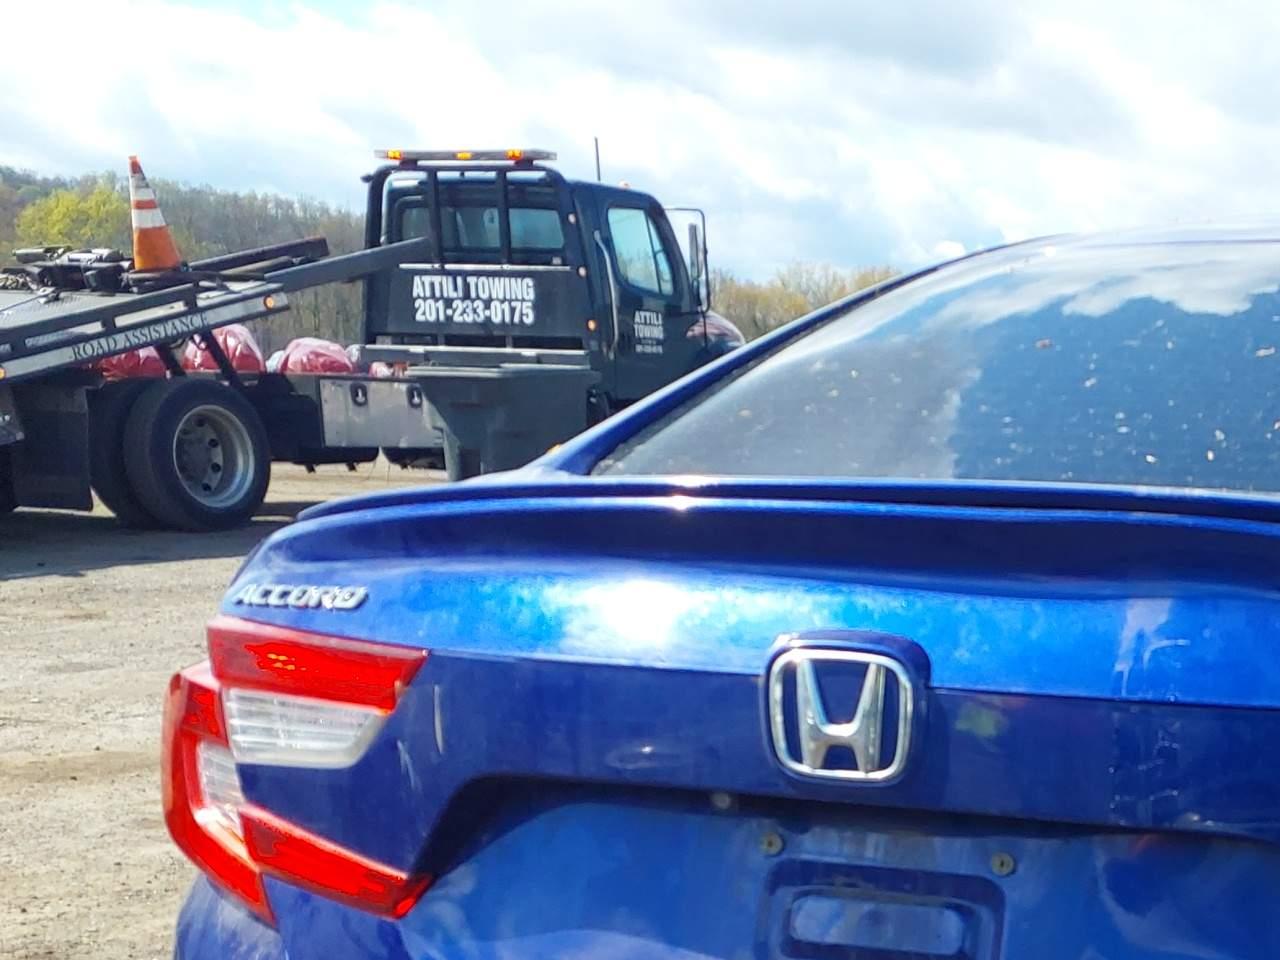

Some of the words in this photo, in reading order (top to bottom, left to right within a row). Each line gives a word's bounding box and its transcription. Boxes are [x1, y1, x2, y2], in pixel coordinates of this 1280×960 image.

[412, 274, 463, 299] ATTILI
[466, 275, 536, 300] TOWING
[414, 298, 535, 325] 201-233-0175
[71, 336, 118, 360] ROAD
[122, 313, 209, 347] ASSISTANCE
[232, 584, 368, 610] ACCORD
